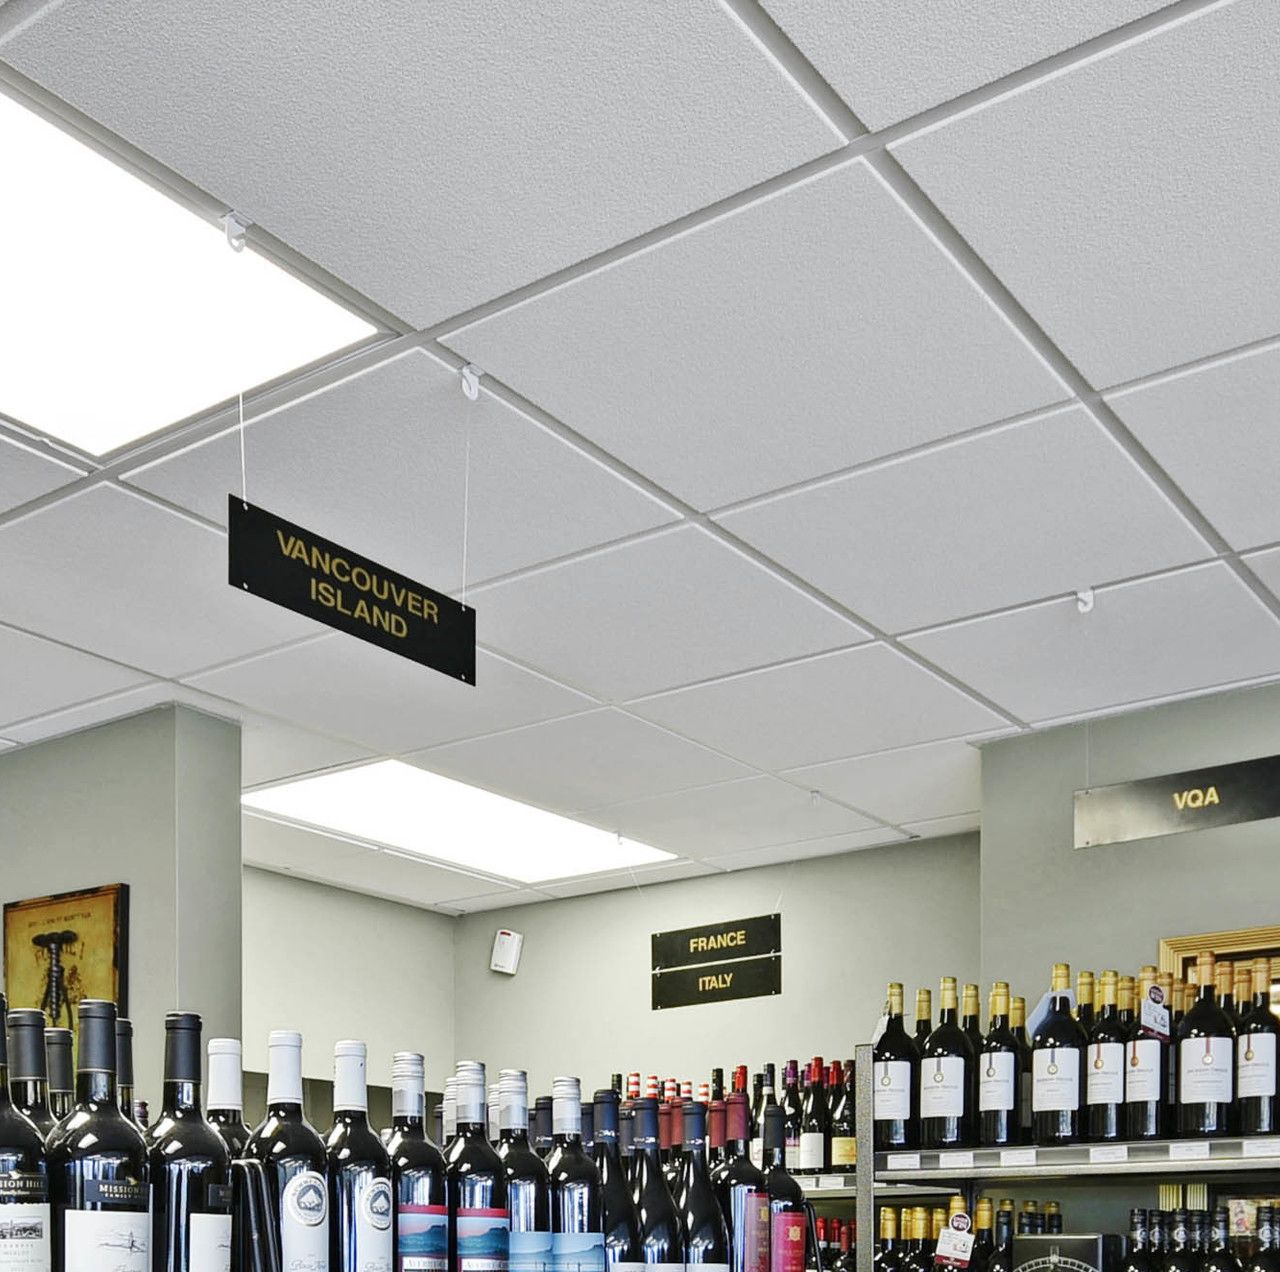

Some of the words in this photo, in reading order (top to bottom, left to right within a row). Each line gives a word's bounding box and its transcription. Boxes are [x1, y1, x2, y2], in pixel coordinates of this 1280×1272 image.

[277, 529, 439, 625] VANCOUVER
[310, 579, 408, 641] ISLAND
[1173, 786, 1219, 810] VQA
[689, 930, 746, 953] FRANCE
[698, 972, 733, 991] ITALY
[99, 1184, 141, 1195] MISSION
